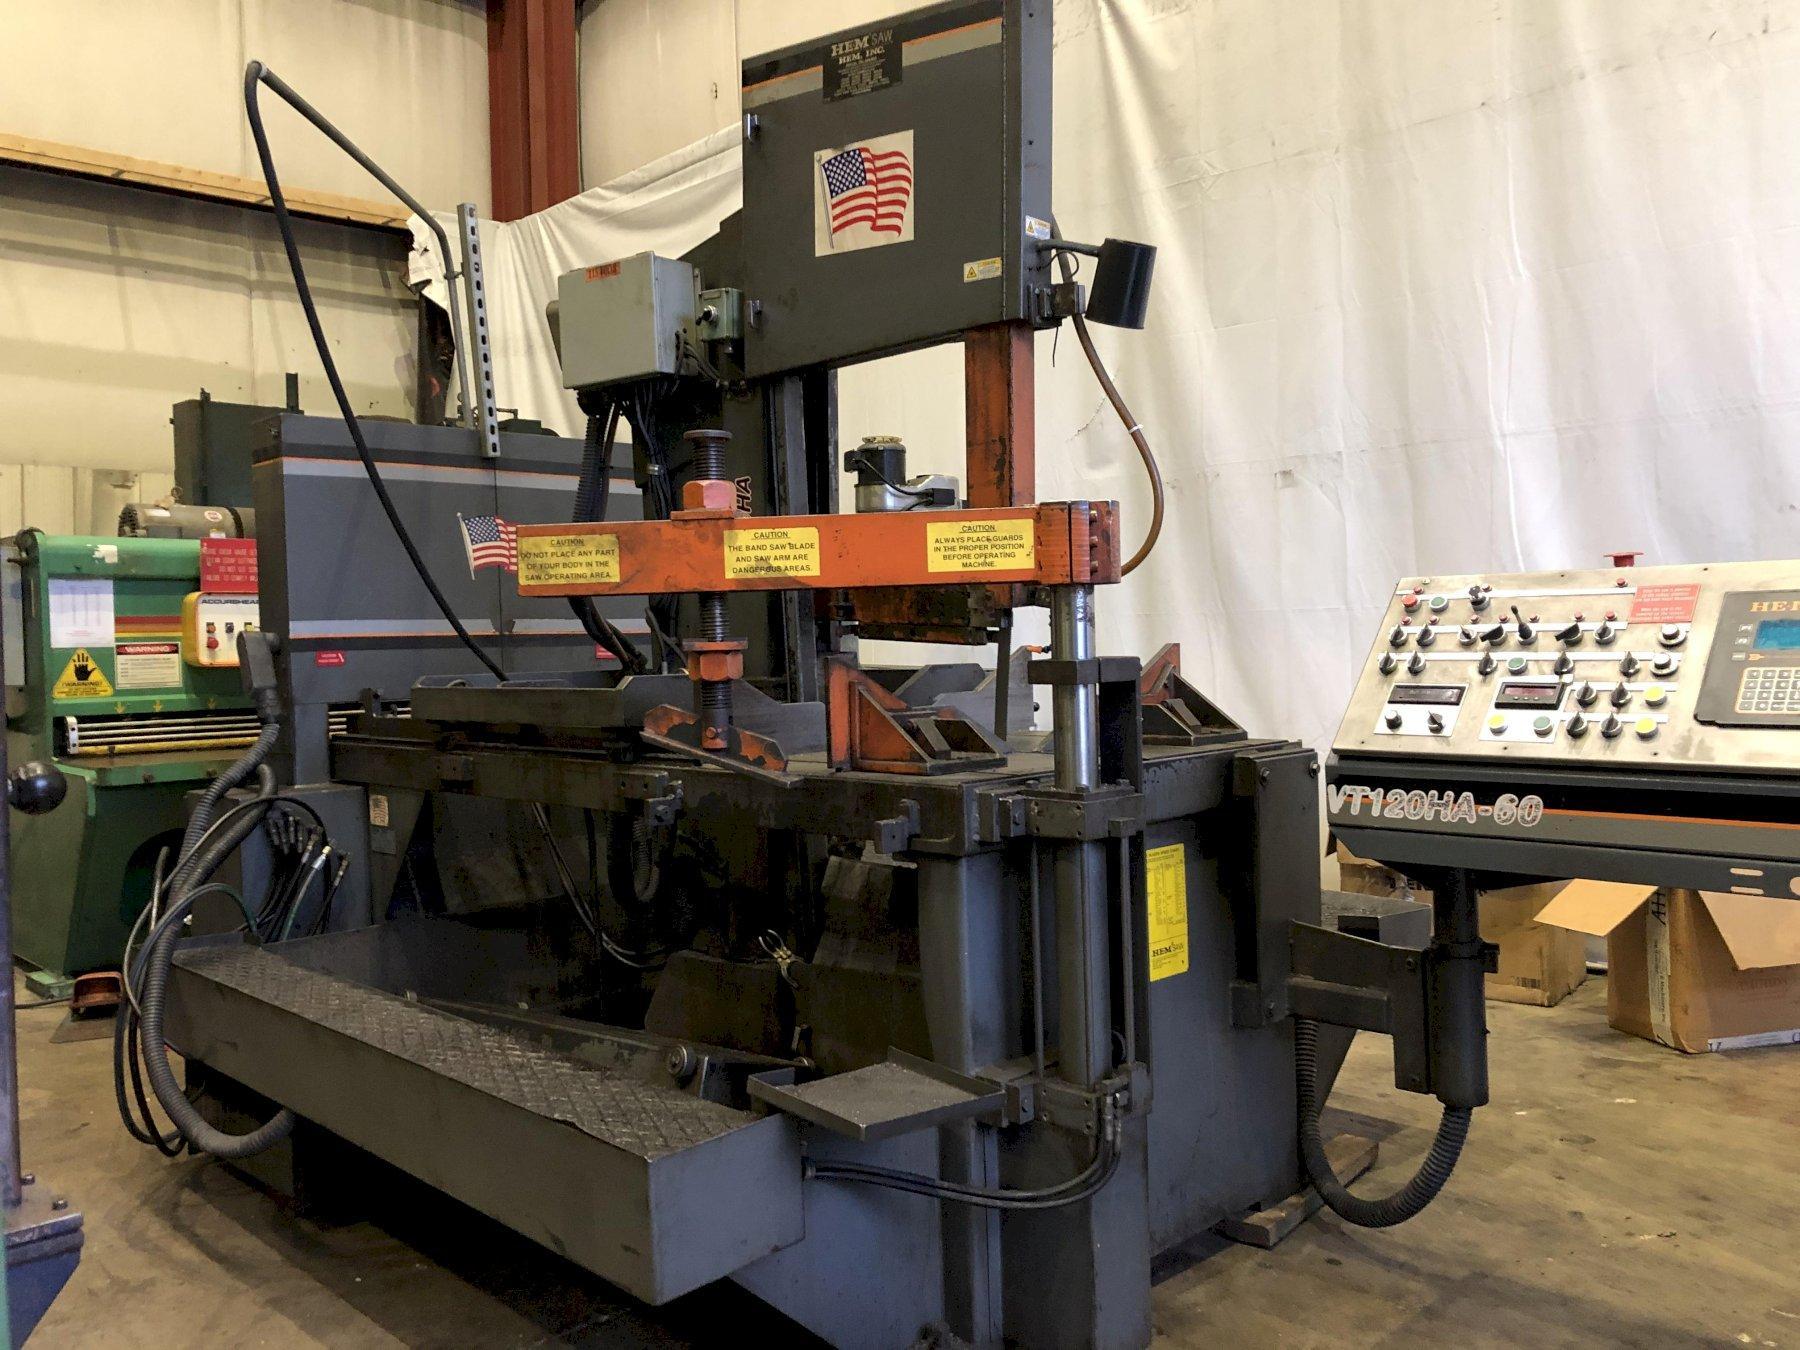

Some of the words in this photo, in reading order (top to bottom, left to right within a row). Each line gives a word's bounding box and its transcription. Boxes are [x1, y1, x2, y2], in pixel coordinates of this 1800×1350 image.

[831, 35, 870, 57] HEM
[871, 29, 893, 46] SAW
[865, 46, 885, 57] INC.
[961, 524, 996, 532] CAUTION
[753, 531, 789, 539] CAUTION
[934, 536, 965, 544] ALWAYS
[966, 535, 991, 543] PLACE
[550, 538, 585, 546] CAUTION
[745, 544, 768, 552] BAND
[788, 542, 816, 550] BLADE
[990, 543, 1025, 551] POSITION
[520, 552, 532, 560] DO
[550, 550, 576, 558] PLACE
[577, 549, 594, 557] ANY
[942, 553, 972, 561] BEFORE
[973, 551, 1016, 560] OPERATING
[540, 562, 561, 570] YOUR
[562, 561, 584, 569] BODY
[732, 565, 782, 574] DANGEROUS
[543, 572, 588, 581] OPERATING
[124, 645, 170, 653] WARNING
[1327, 784, 1544, 827] VT120HA-60
[1152, 945, 1172, 957] HEM
